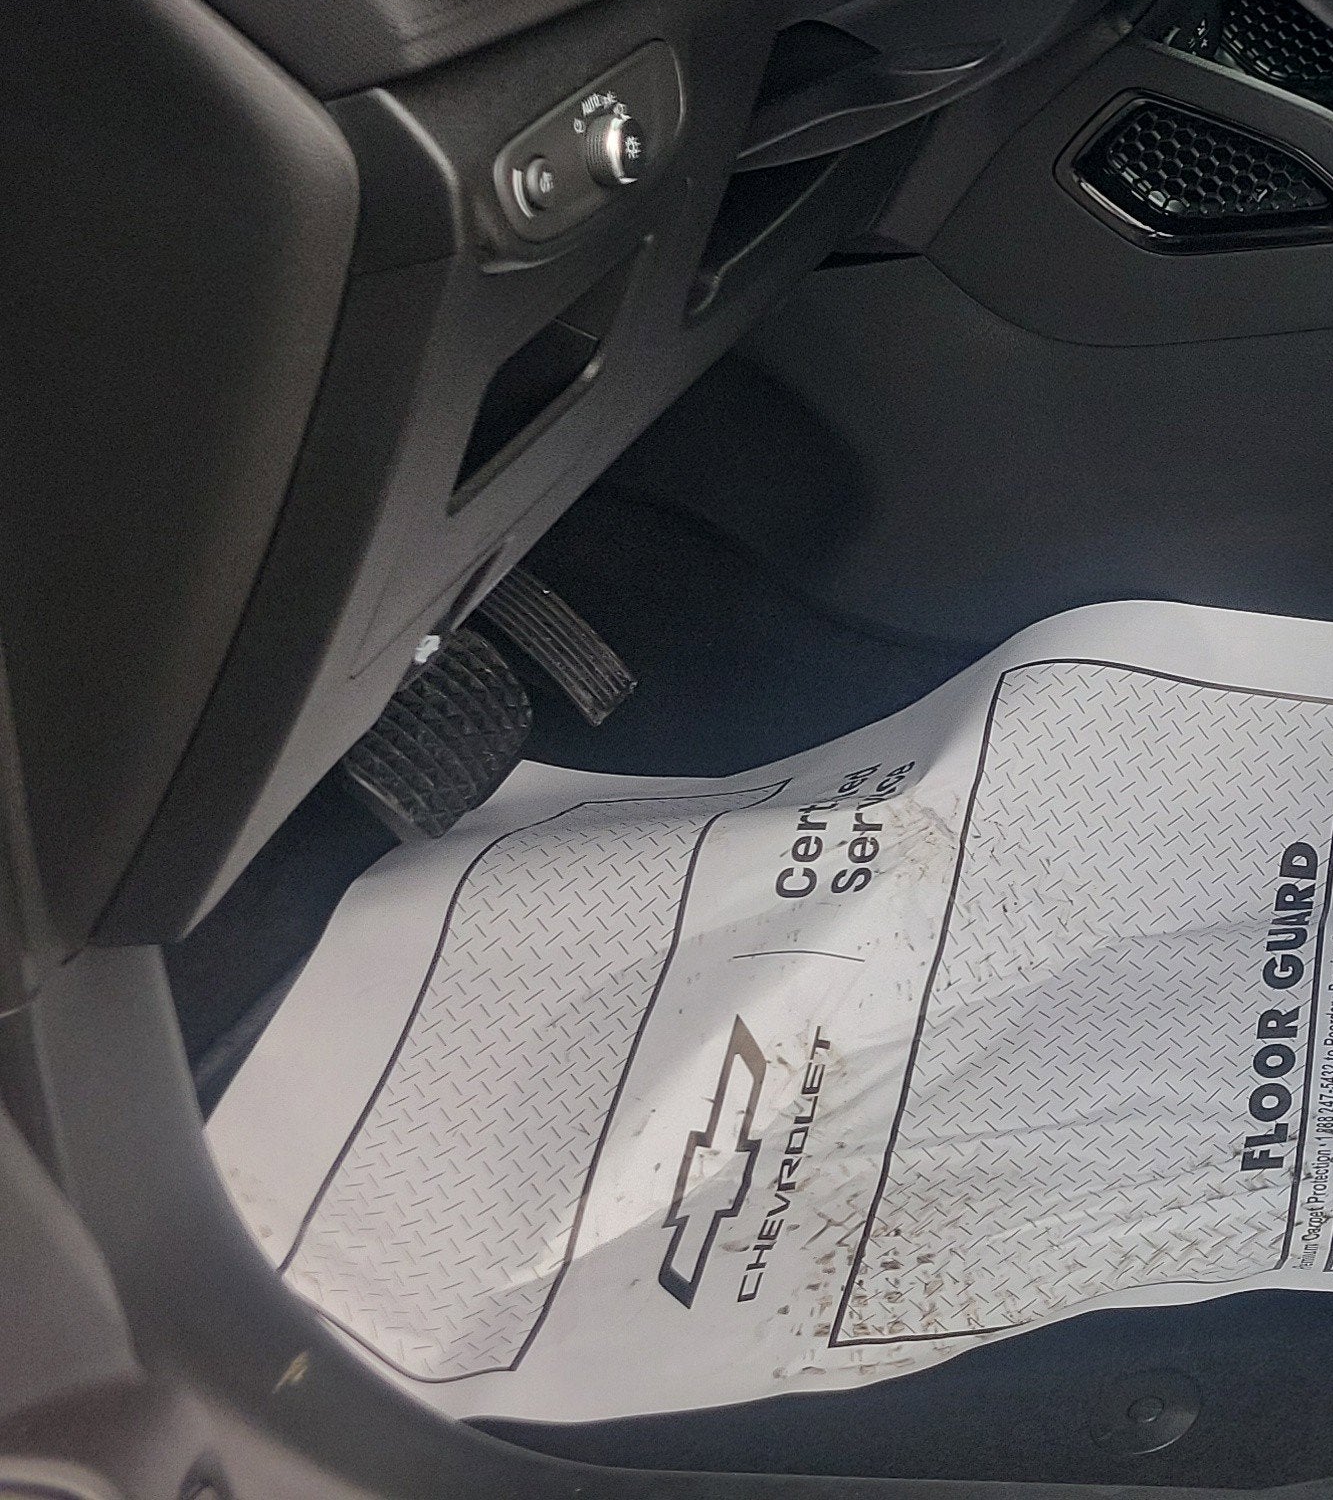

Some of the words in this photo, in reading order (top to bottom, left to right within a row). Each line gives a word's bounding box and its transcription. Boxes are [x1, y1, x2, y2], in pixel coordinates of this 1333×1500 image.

[1262, 842, 1319, 990] GUARD
[1240, 1005, 1300, 1172] FLOOR
[737, 1025, 831, 1302] CHEVROLET
[1302, 1204, 1325, 1241] Carpet
[1307, 1149, 1331, 1206] Protection
